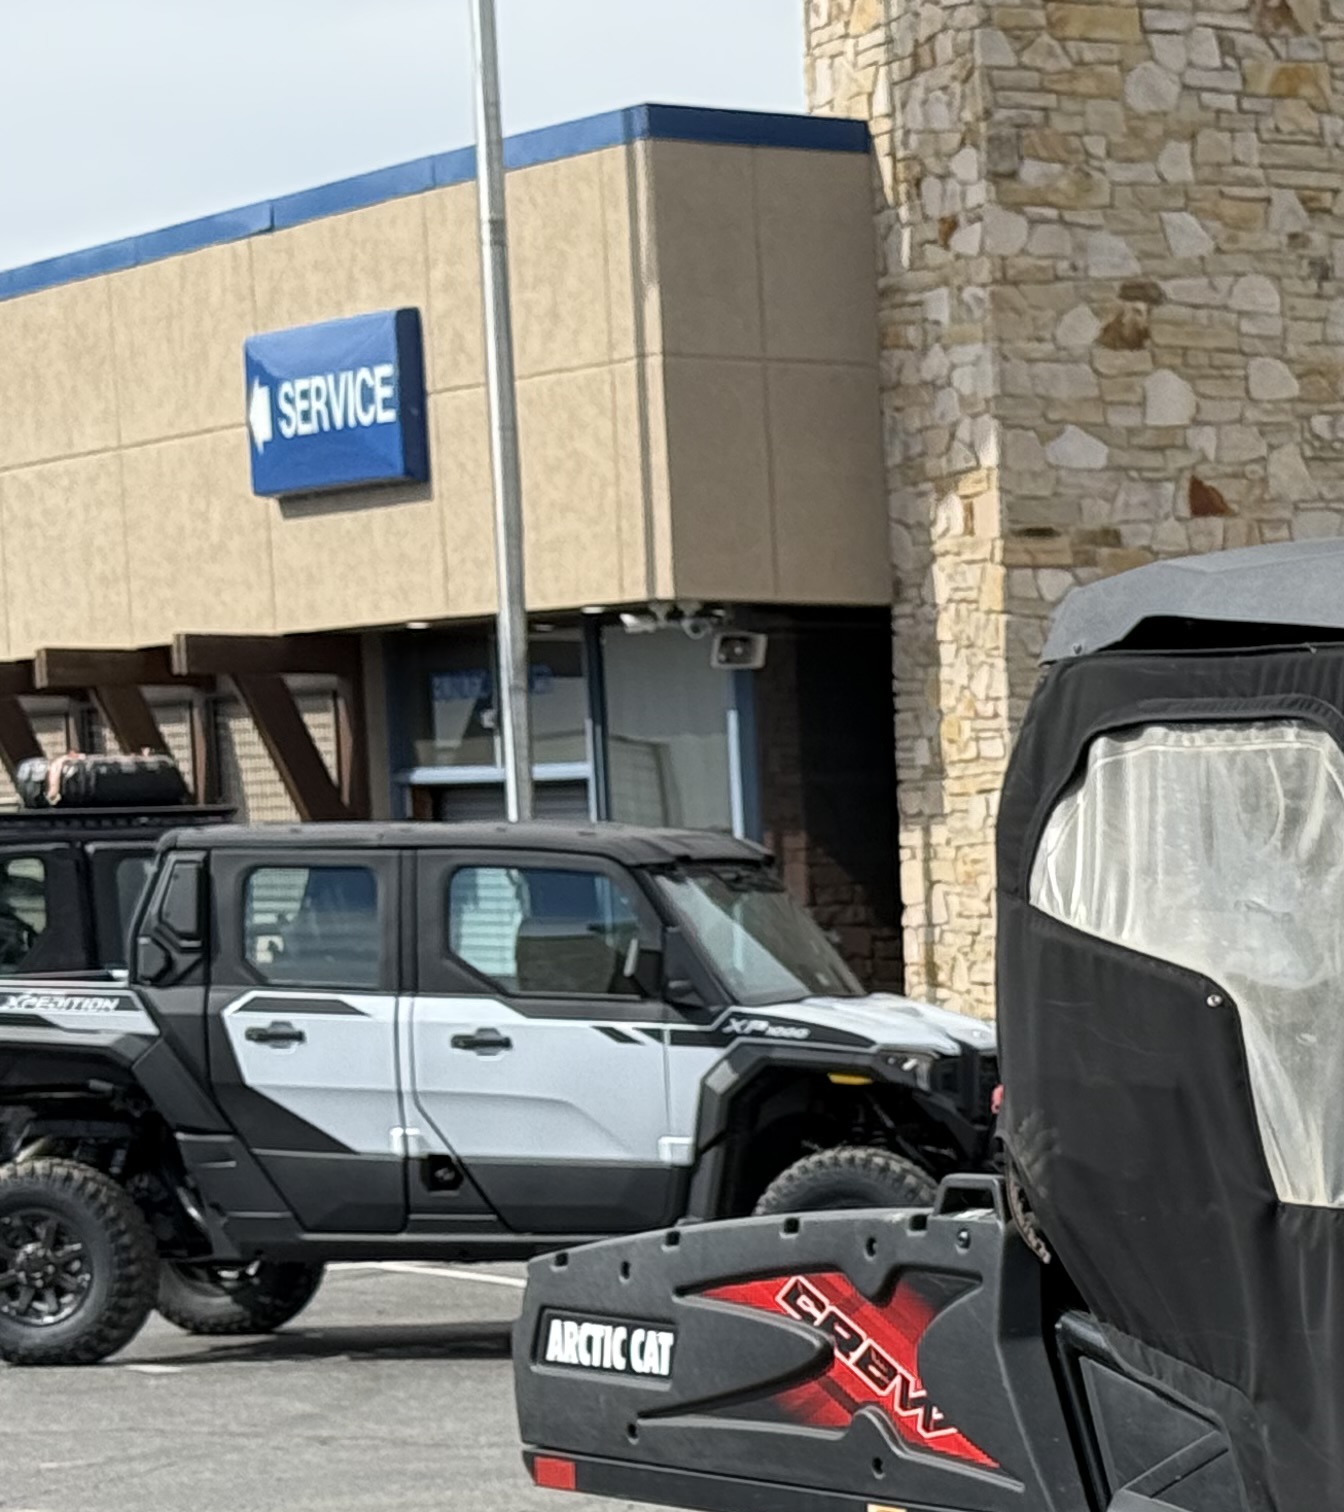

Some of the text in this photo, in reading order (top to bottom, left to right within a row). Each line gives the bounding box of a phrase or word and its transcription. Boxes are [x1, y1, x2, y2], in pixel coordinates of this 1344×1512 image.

[278, 364, 396, 440] SERVICE
[721, 1018, 769, 1034] XP
[545, 1319, 674, 1376] ARCTIC CAT
[774, 1275, 958, 1438] CREW
